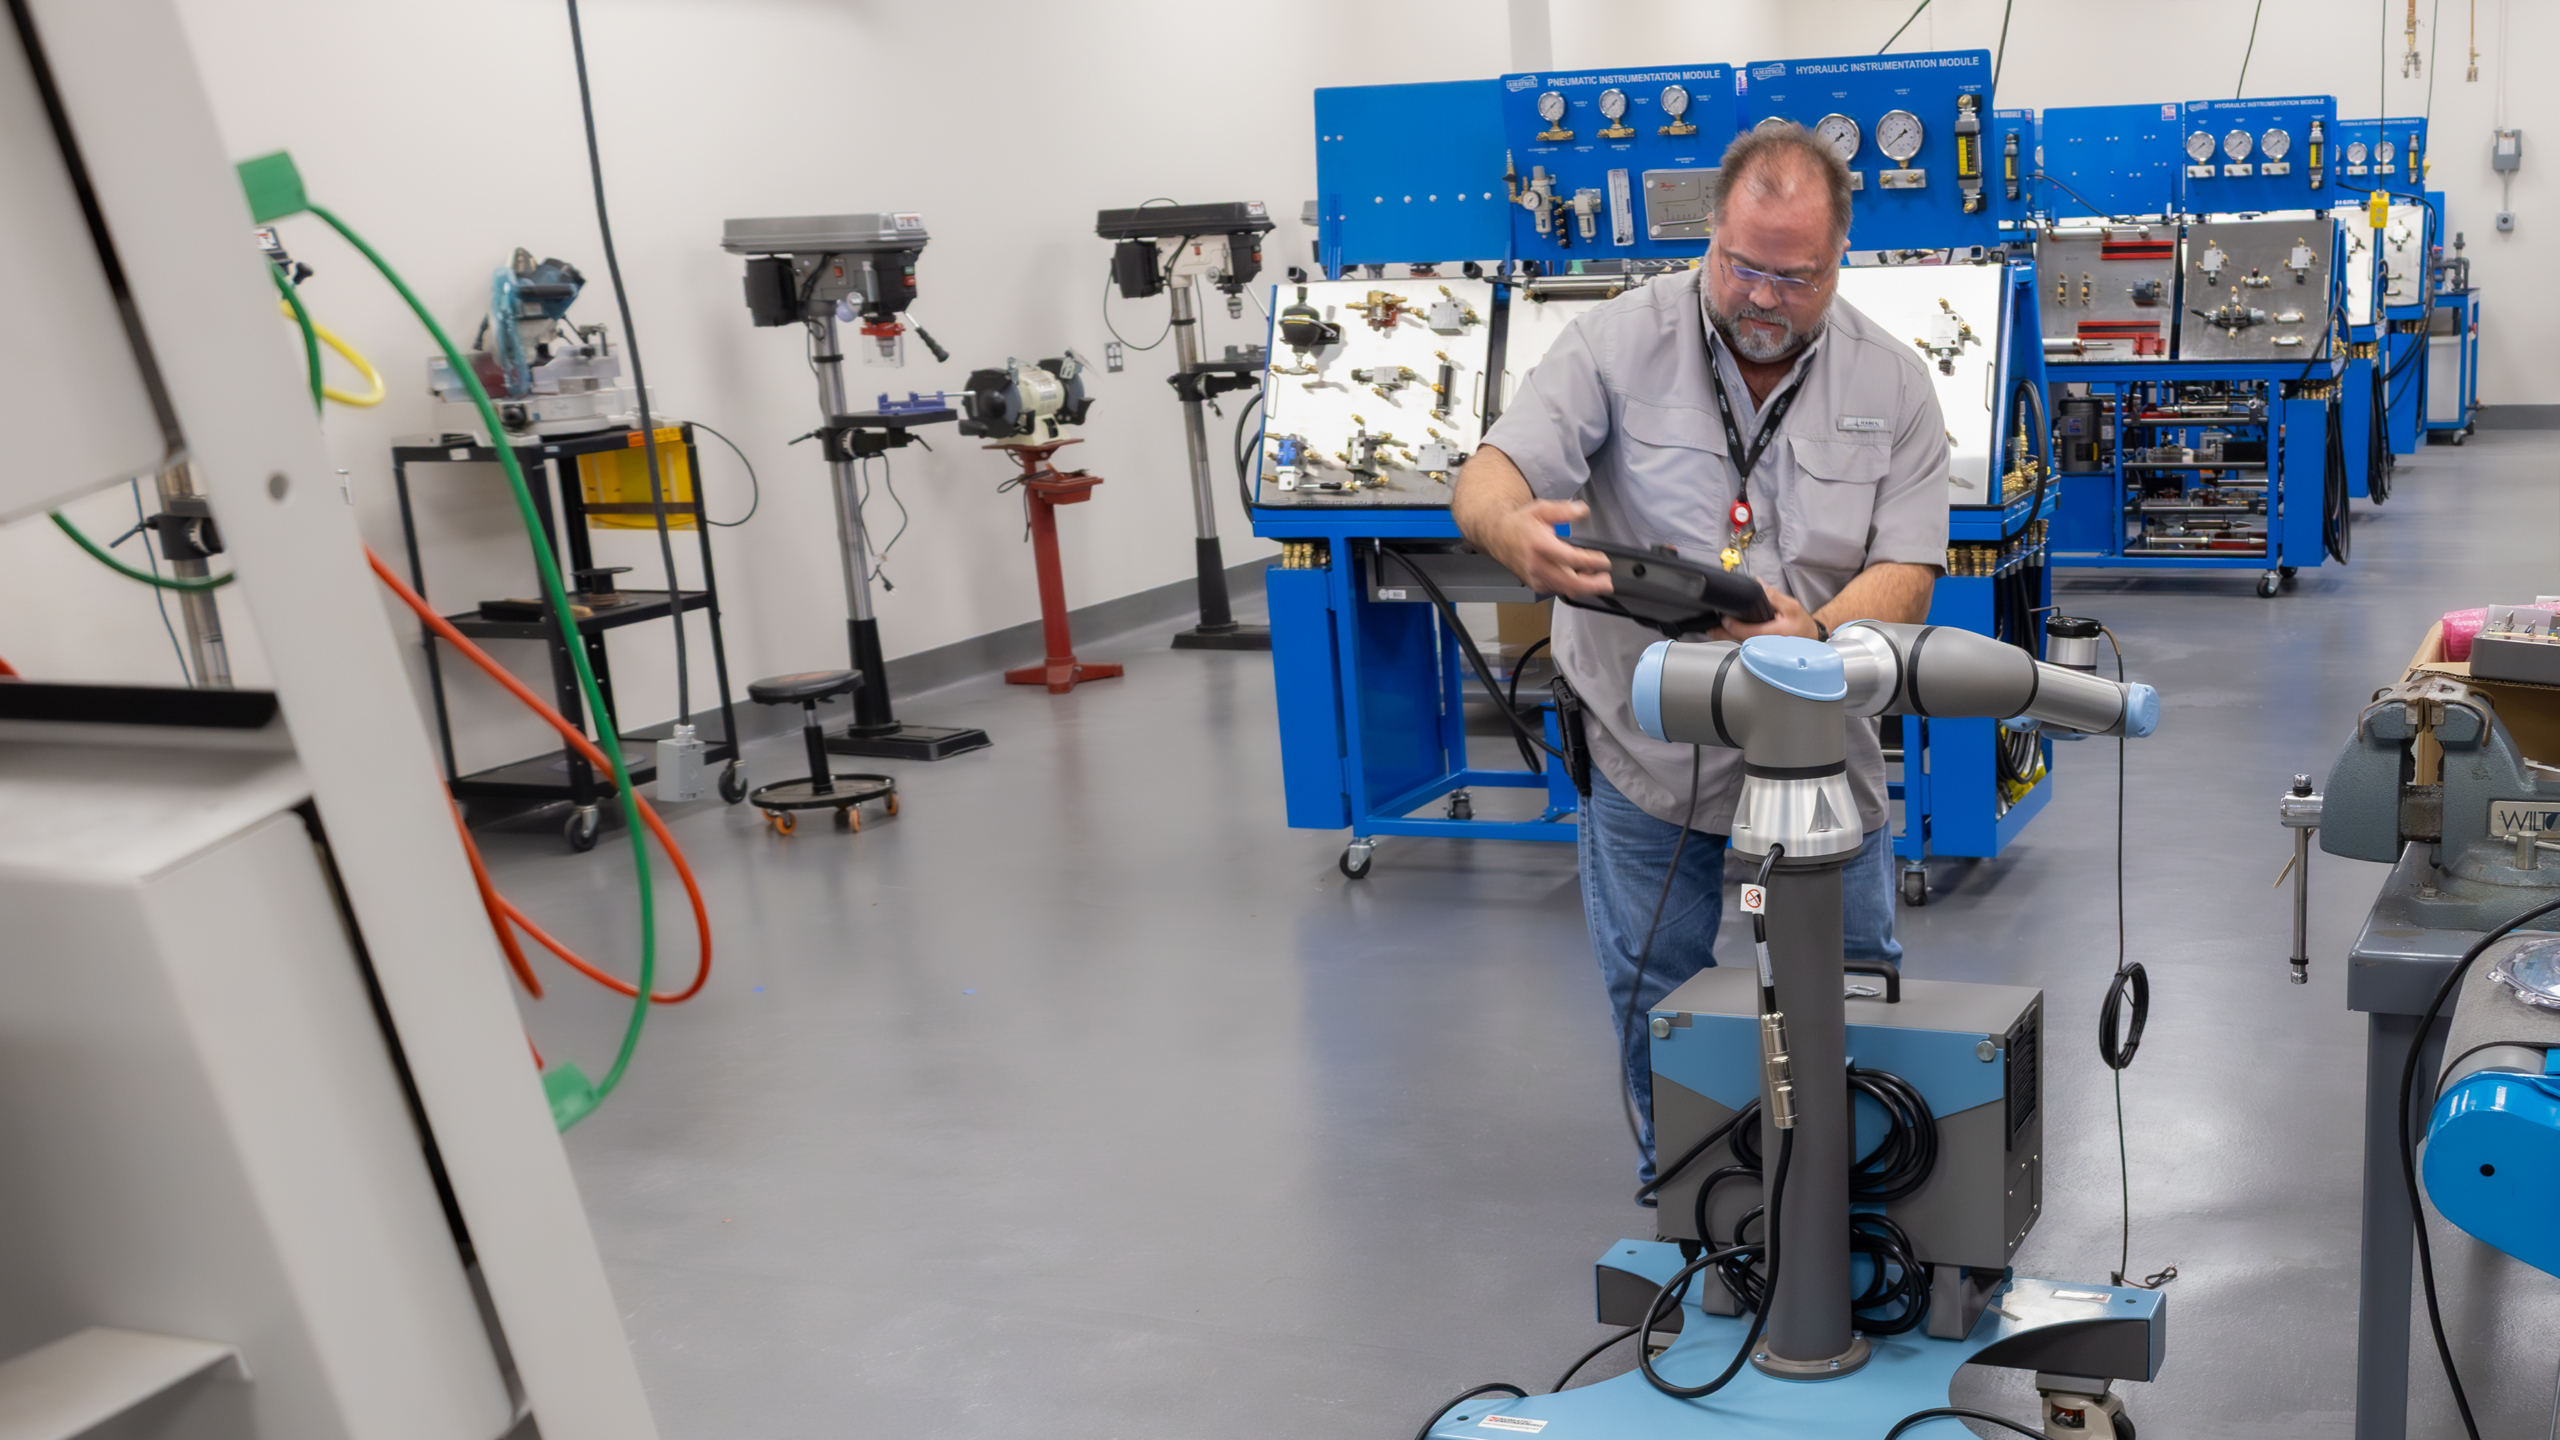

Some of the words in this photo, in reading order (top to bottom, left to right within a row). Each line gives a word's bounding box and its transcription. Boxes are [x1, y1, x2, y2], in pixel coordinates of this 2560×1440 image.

[1796, 63, 1849, 75] HYDRAULIC
[1850, 58, 1937, 73] INSTRUMENTATION
[1939, 56, 1980, 67] MODULE
[1547, 76, 1598, 87] PNEUMATIC
[1599, 72, 1681, 85] INSTRUMENTATION
[1682, 69, 1721, 80] MODULE
[2247, 99, 2300, 108] INSTRUMENTATION
[2300, 98, 2325, 106] MODULE
[899, 216, 920, 227] JET
